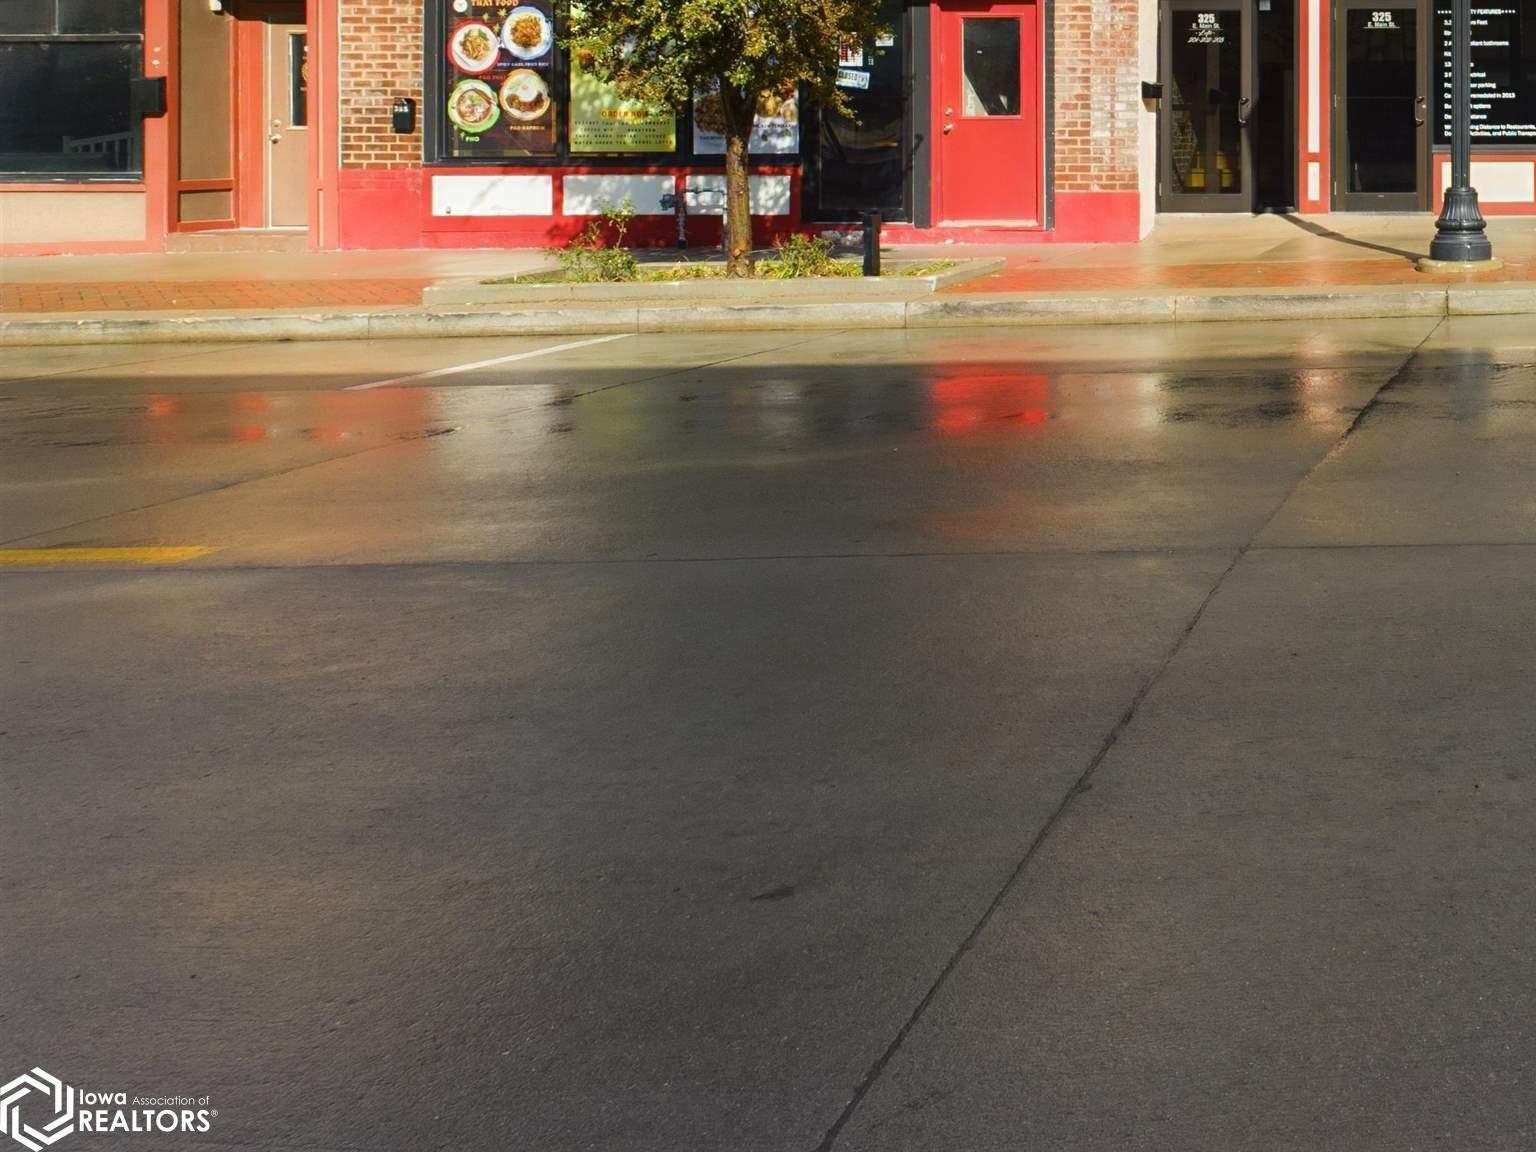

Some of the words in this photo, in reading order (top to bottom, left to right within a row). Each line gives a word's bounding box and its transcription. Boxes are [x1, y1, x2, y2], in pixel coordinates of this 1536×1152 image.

[471, 0, 493, 7] THAI
[496, 0, 519, 7] FOOD
[1197, 13, 1215, 23] 325
[1372, 11, 1392, 22] 325
